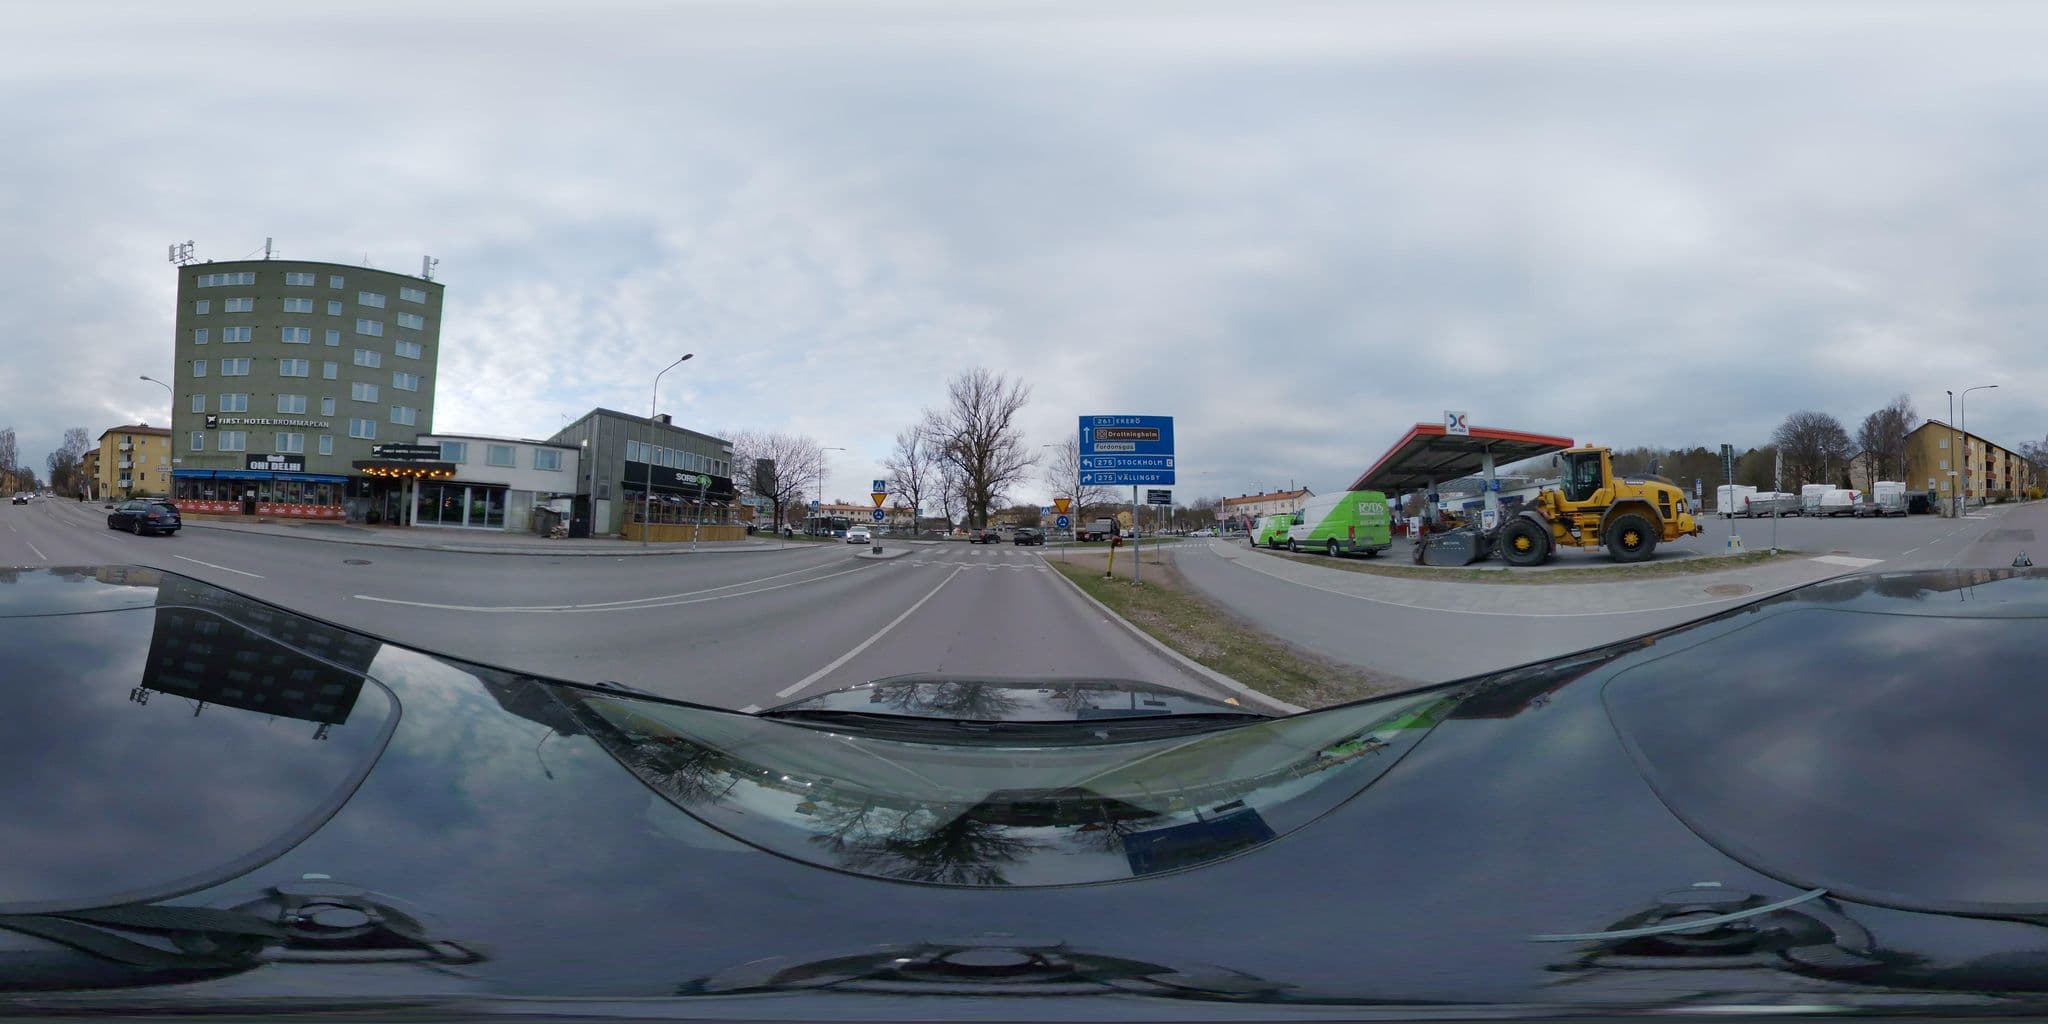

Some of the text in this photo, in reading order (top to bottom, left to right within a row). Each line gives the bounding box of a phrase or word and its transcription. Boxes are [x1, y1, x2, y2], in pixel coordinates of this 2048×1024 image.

[273, 418, 329, 428] BROMMAPLAN
[1108, 431, 1158, 440] Drottningholm
[1096, 443, 1134, 451] Fordonsgas
[271, 462, 301, 471] DELHI
[1117, 473, 1160, 481] VÄLLINGBY
